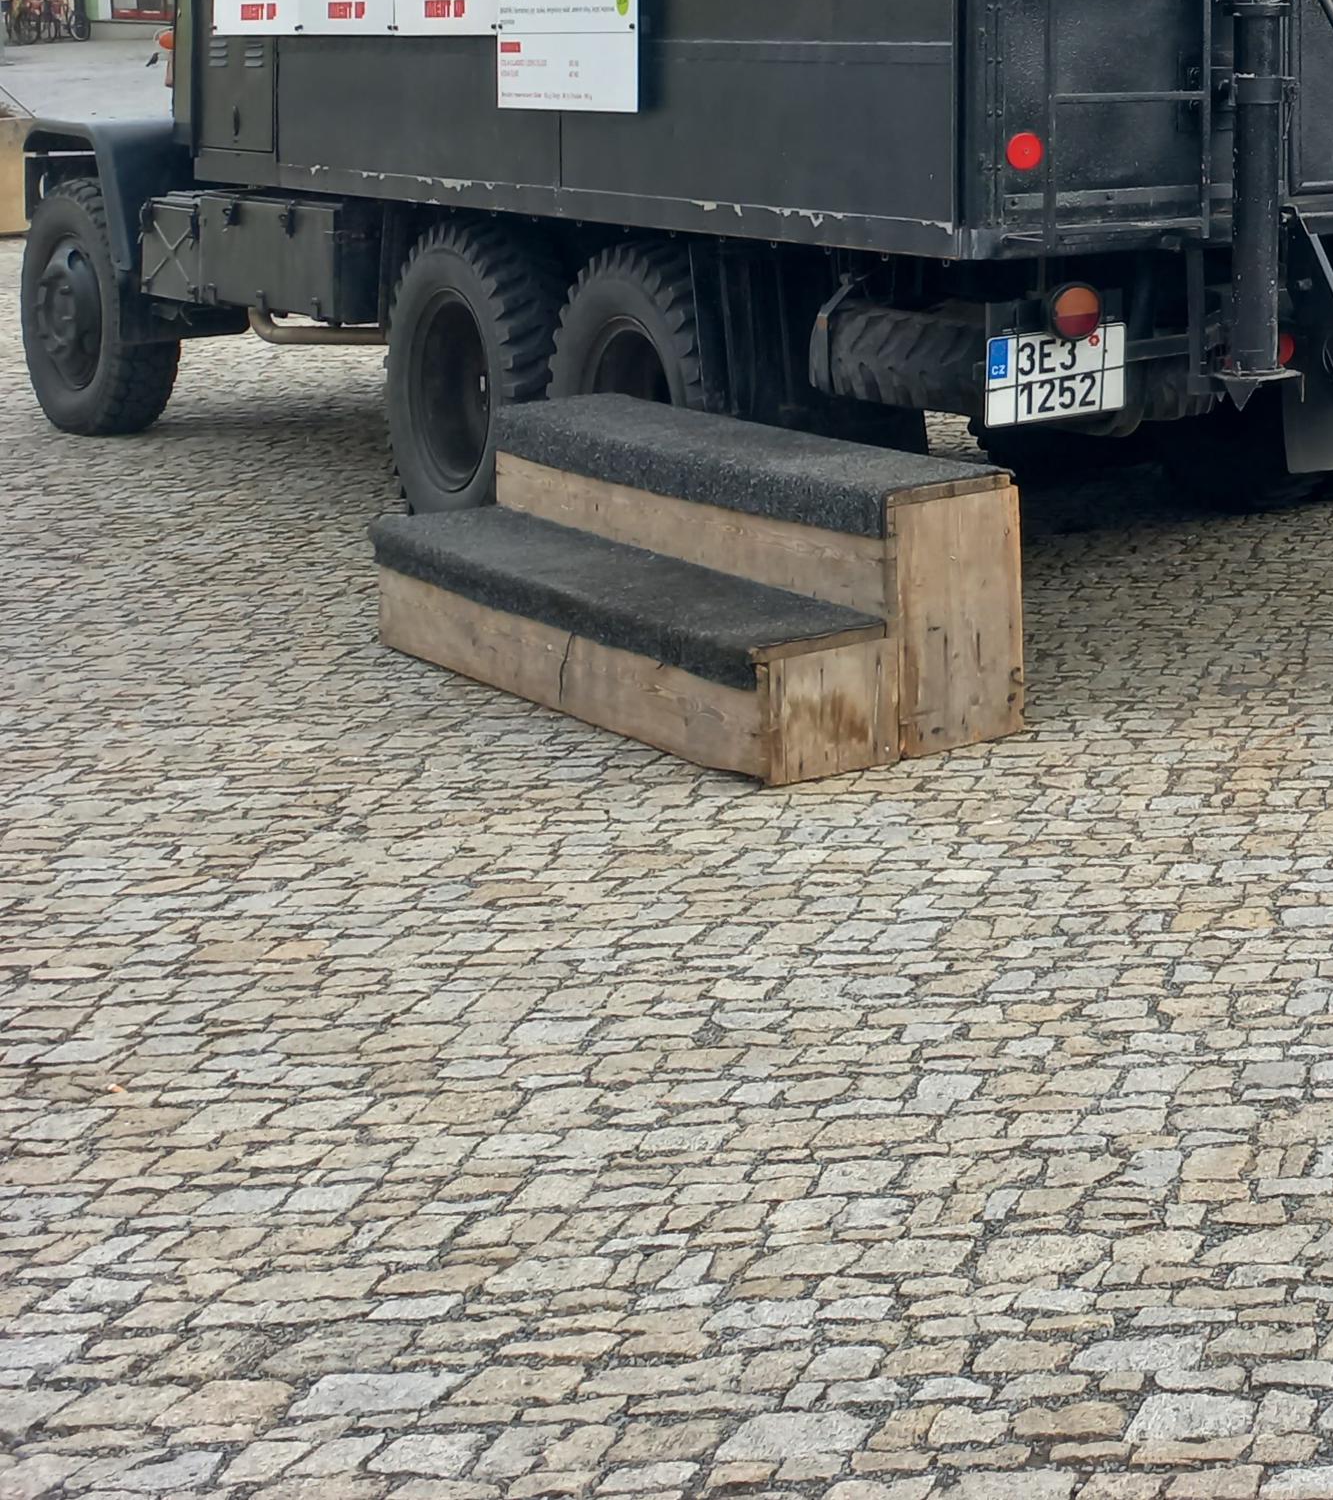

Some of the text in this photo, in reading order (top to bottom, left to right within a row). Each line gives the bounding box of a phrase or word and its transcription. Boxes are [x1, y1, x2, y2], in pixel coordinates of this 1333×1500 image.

[991, 364, 1006, 376] CZ
[1018, 339, 1078, 376] 3E3
[1019, 373, 1096, 415] 1252
